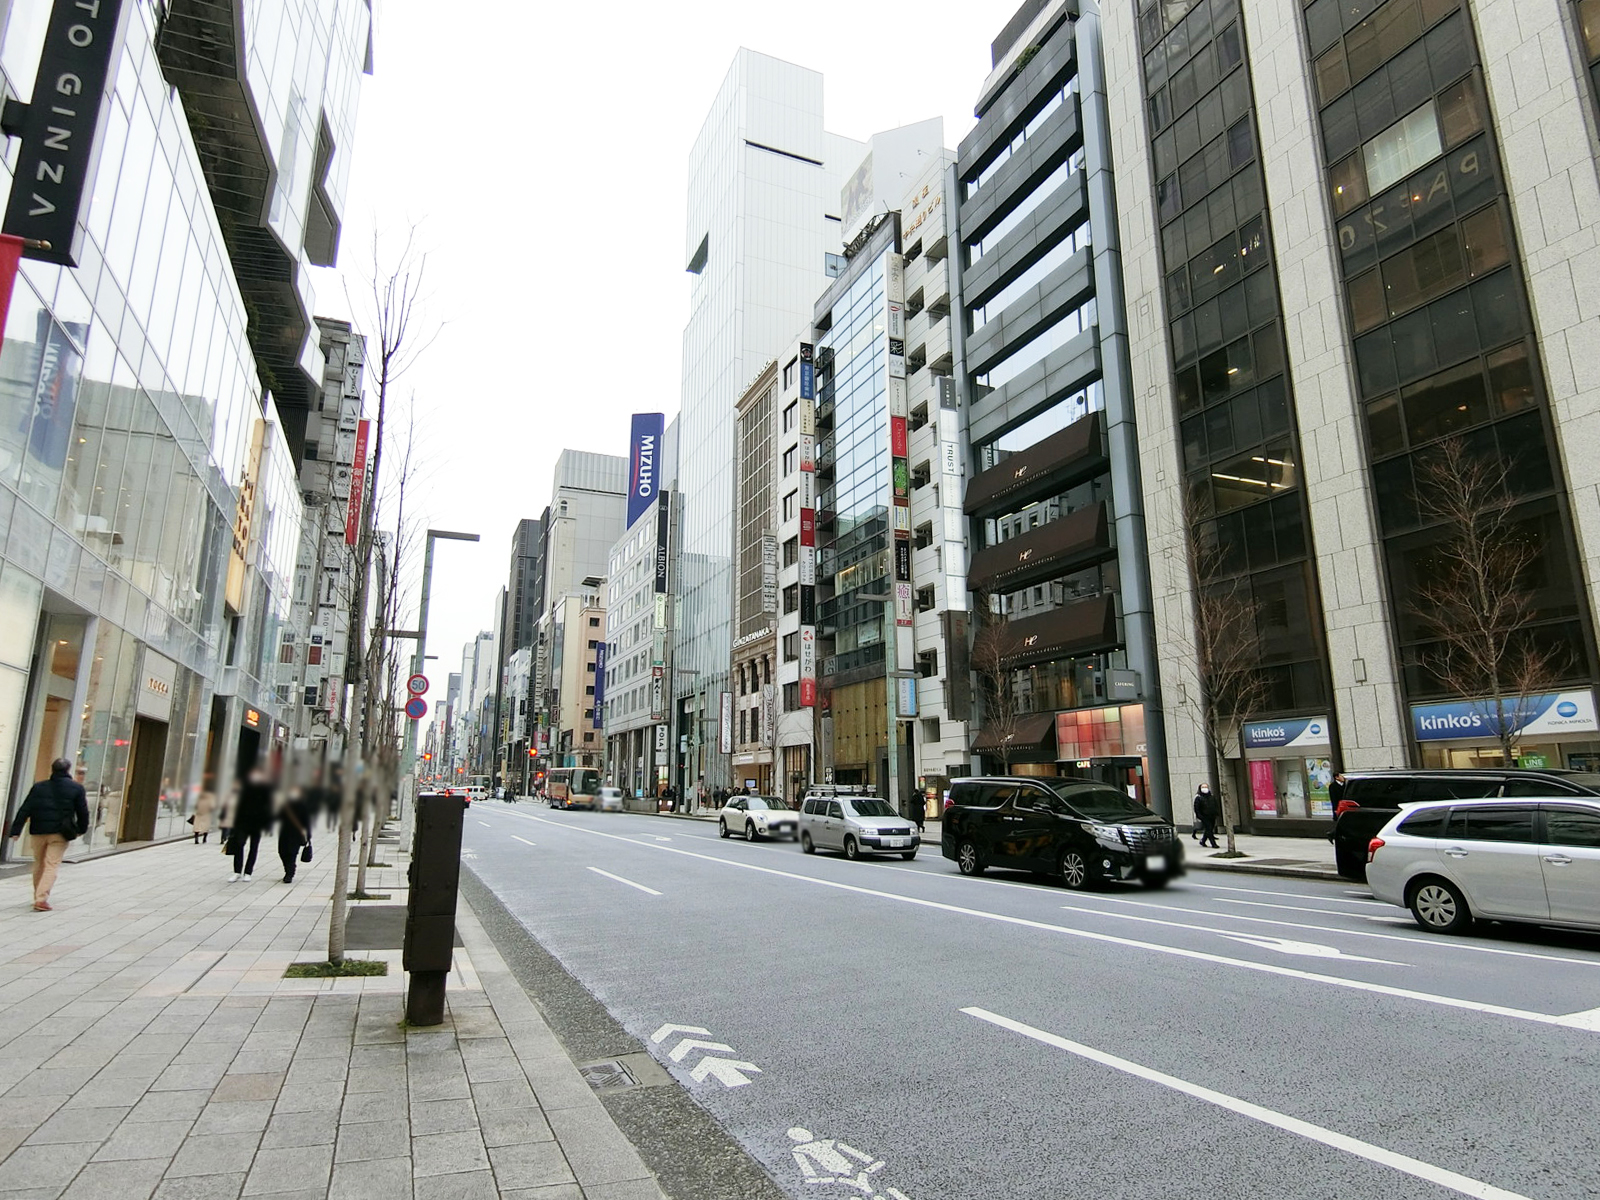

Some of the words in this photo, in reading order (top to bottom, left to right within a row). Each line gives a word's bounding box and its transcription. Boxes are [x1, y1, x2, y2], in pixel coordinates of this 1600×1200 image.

[639, 435, 654, 498] MIZUHO
[947, 444, 955, 474] TRUST
[657, 546, 666, 579] ALBION
[804, 643, 812, 673] はせがわ
[412, 679, 425, 691] 50
[1251, 727, 1285, 739] kinko's
[1420, 711, 1482, 731] kinko's
